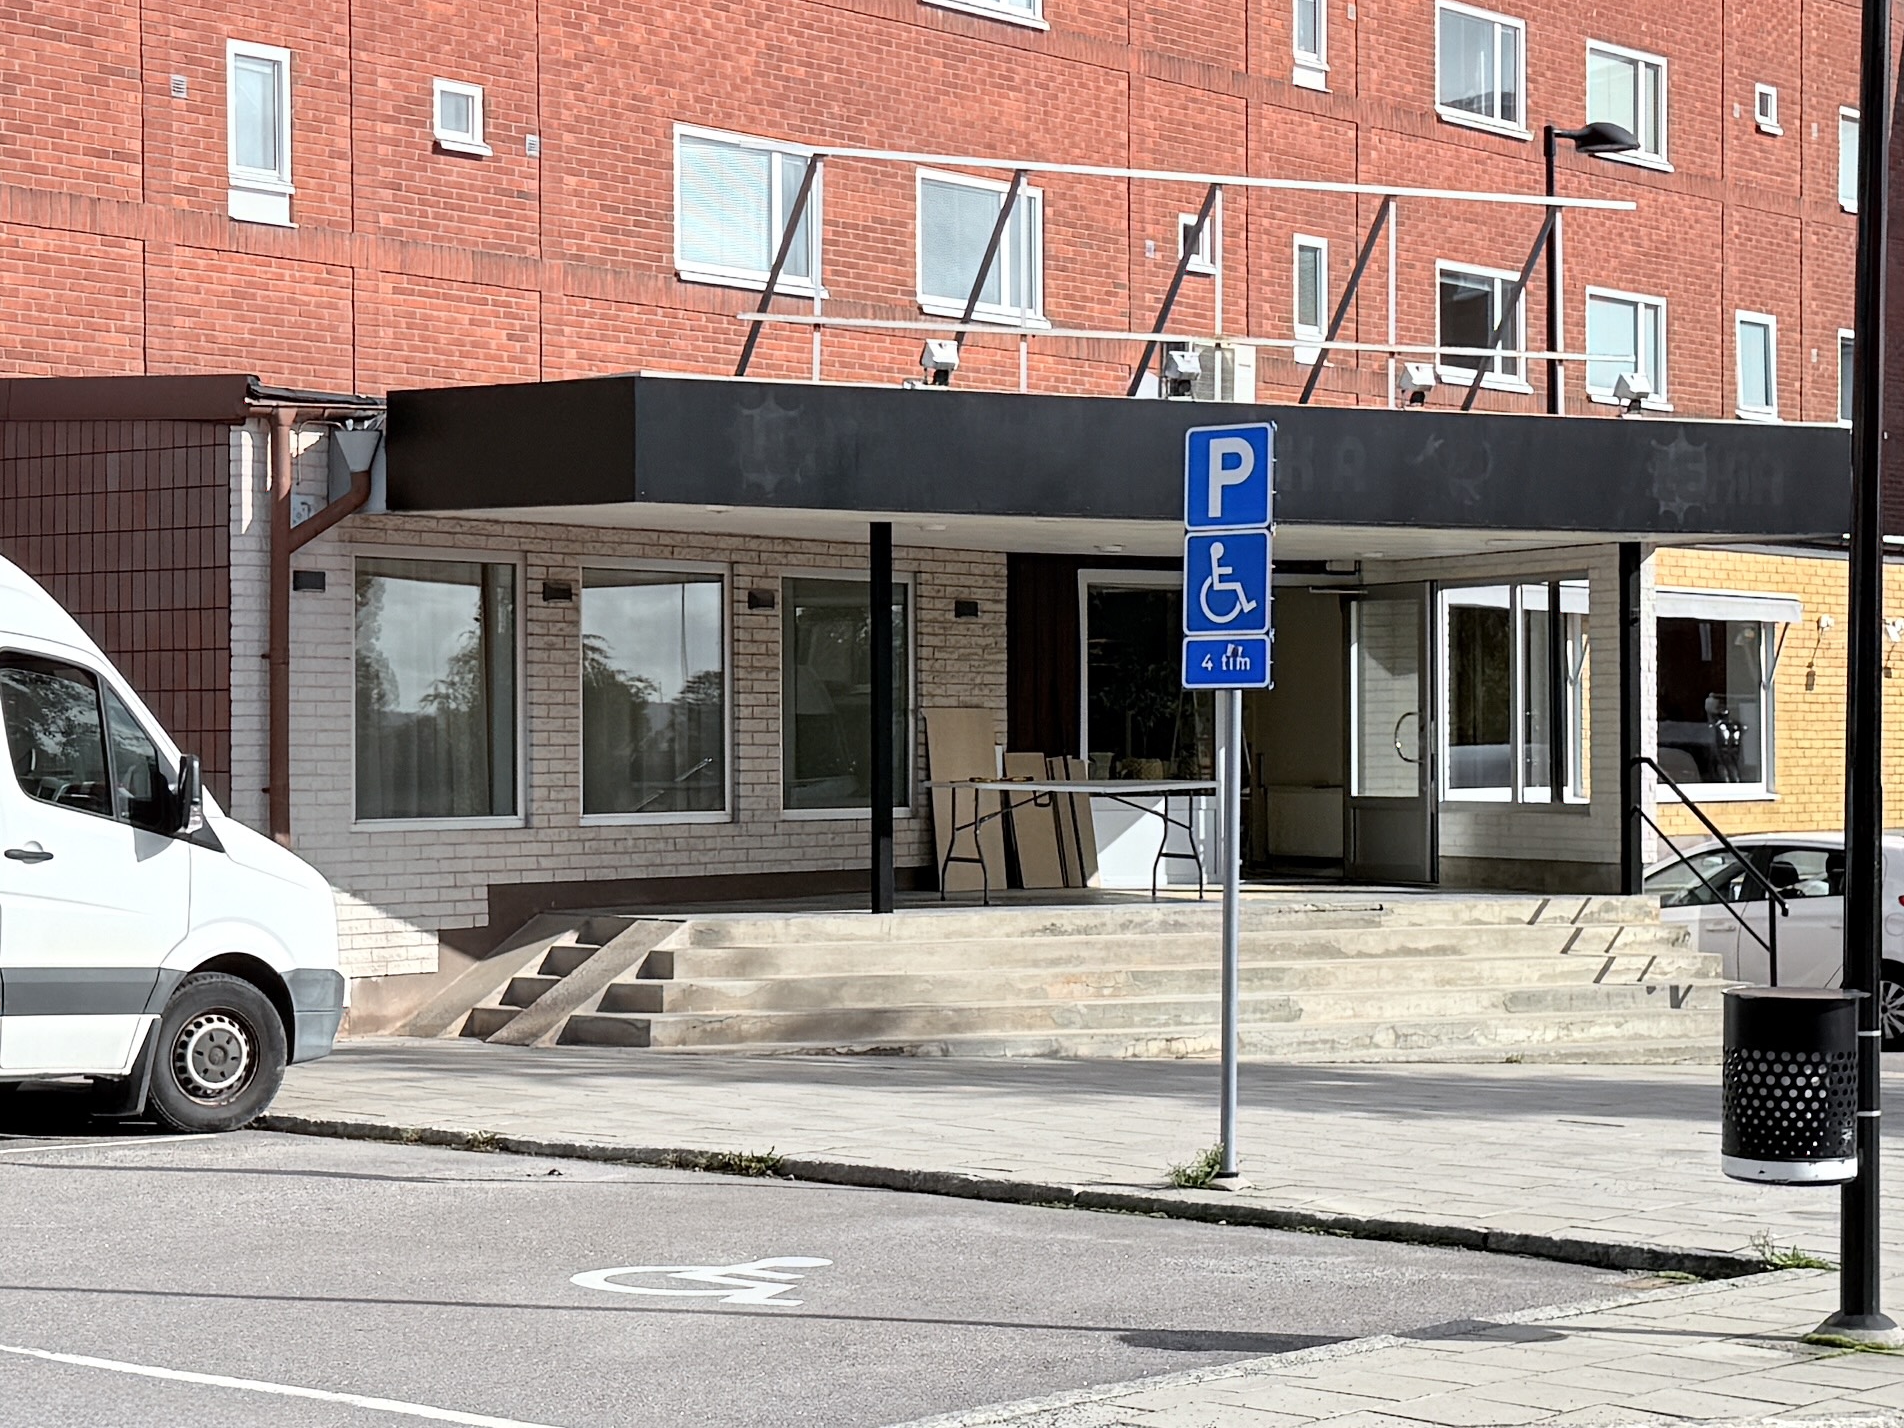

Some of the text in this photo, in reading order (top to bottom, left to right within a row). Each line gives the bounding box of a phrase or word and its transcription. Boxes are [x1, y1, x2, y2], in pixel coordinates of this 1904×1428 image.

[1208, 437, 1255, 518] P
[1201, 652, 1251, 671] 4 tim
